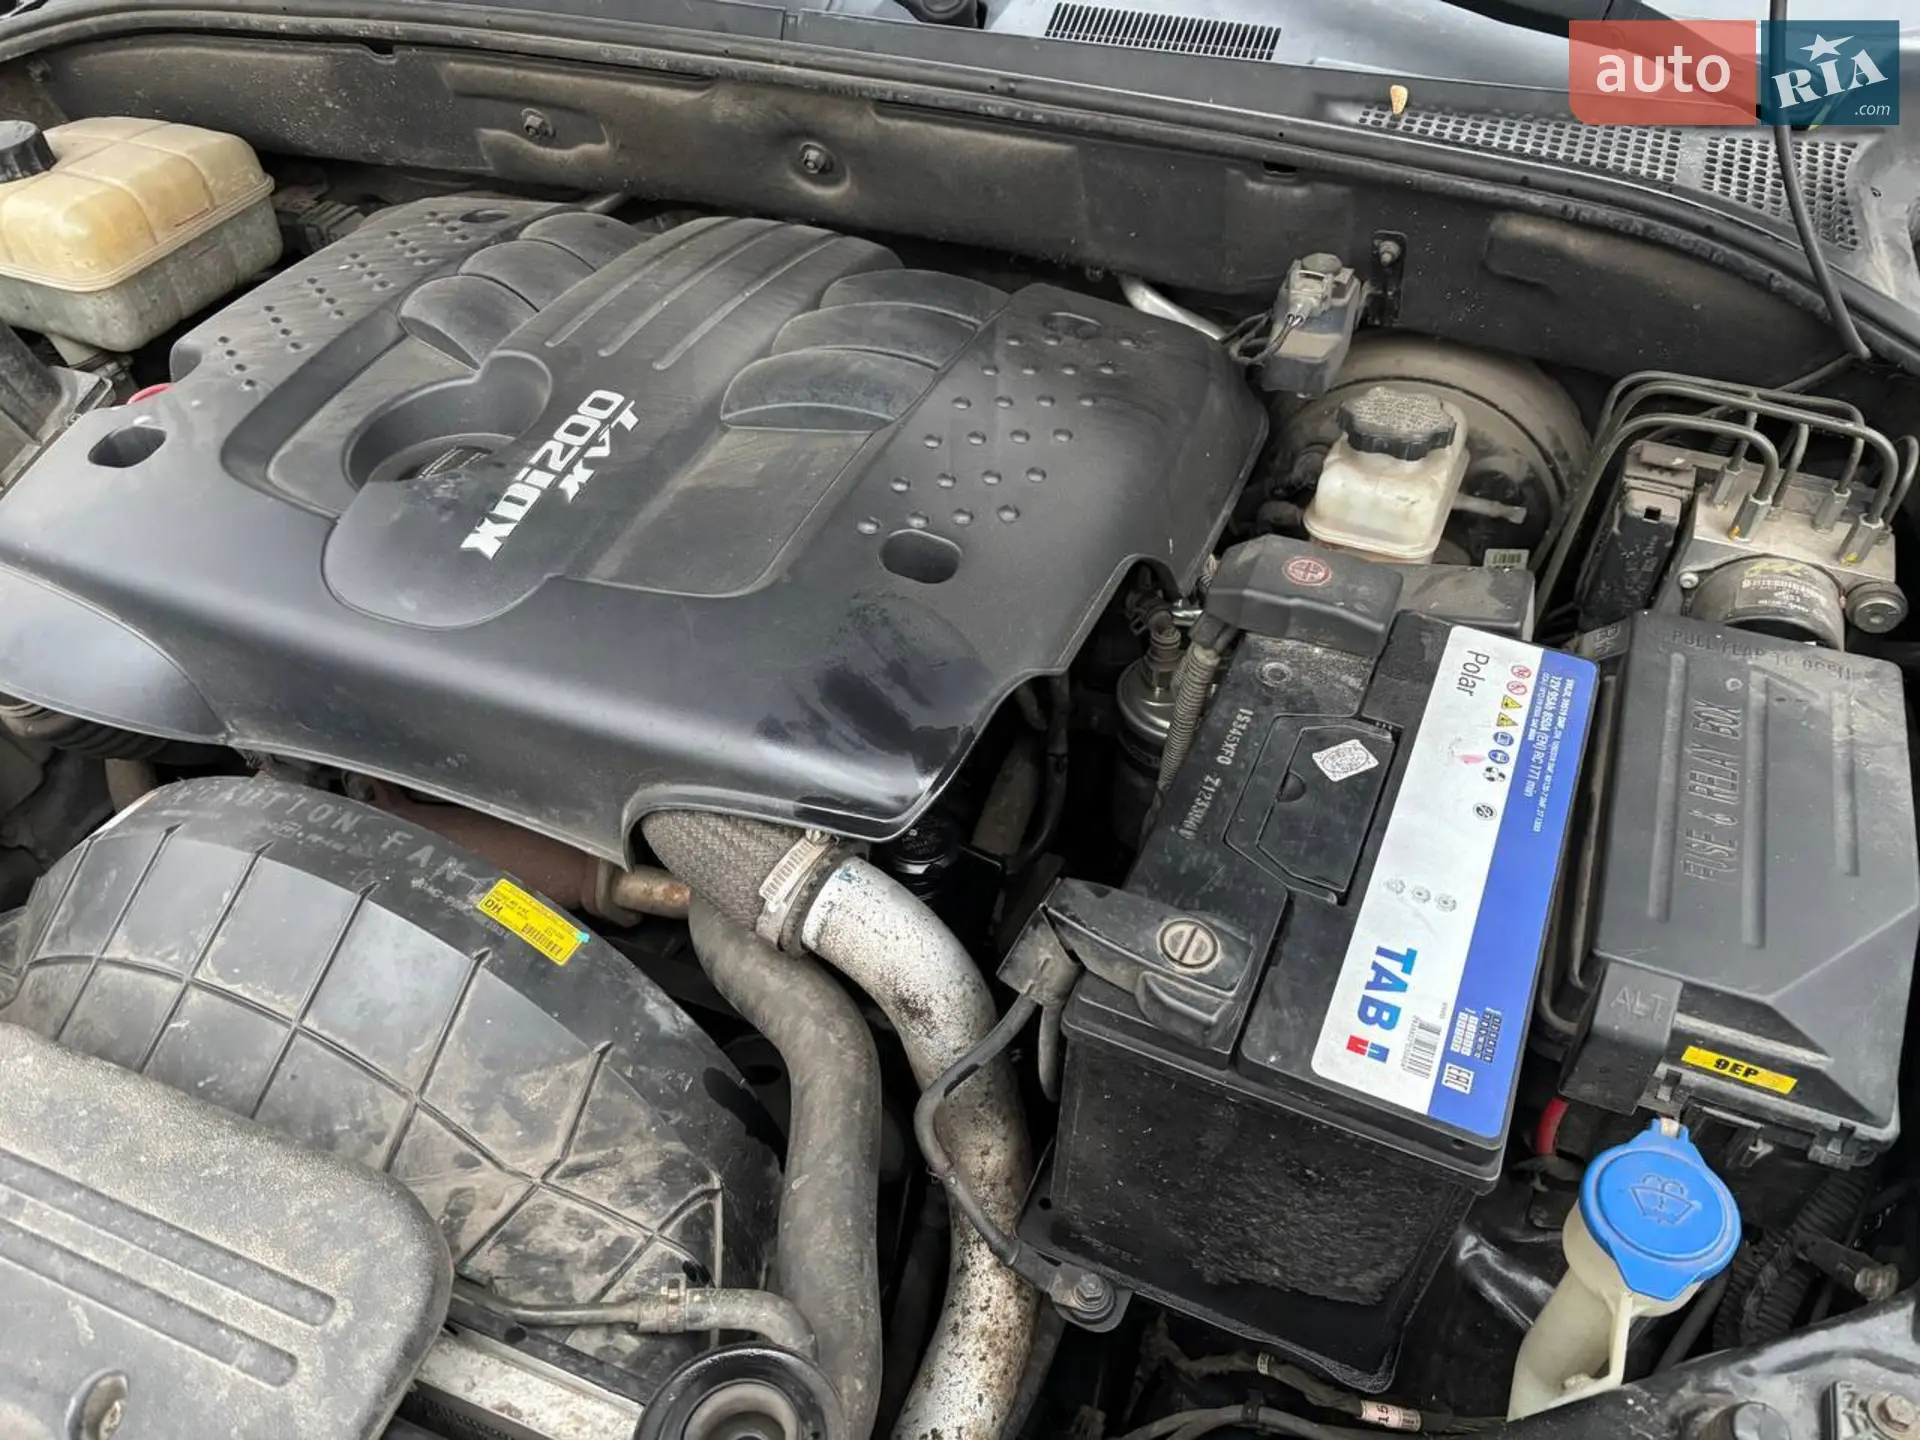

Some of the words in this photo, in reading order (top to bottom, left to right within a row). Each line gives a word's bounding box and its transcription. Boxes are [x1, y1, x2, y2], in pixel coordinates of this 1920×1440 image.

[559, 400, 640, 503] XVT
[1456, 650, 1490, 696] Polar
[1692, 699, 1741, 740] BOX
[1688, 743, 1740, 805] RELAY
[1357, 945, 1418, 1031] TAB
[1610, 985, 1669, 1023] ALT
